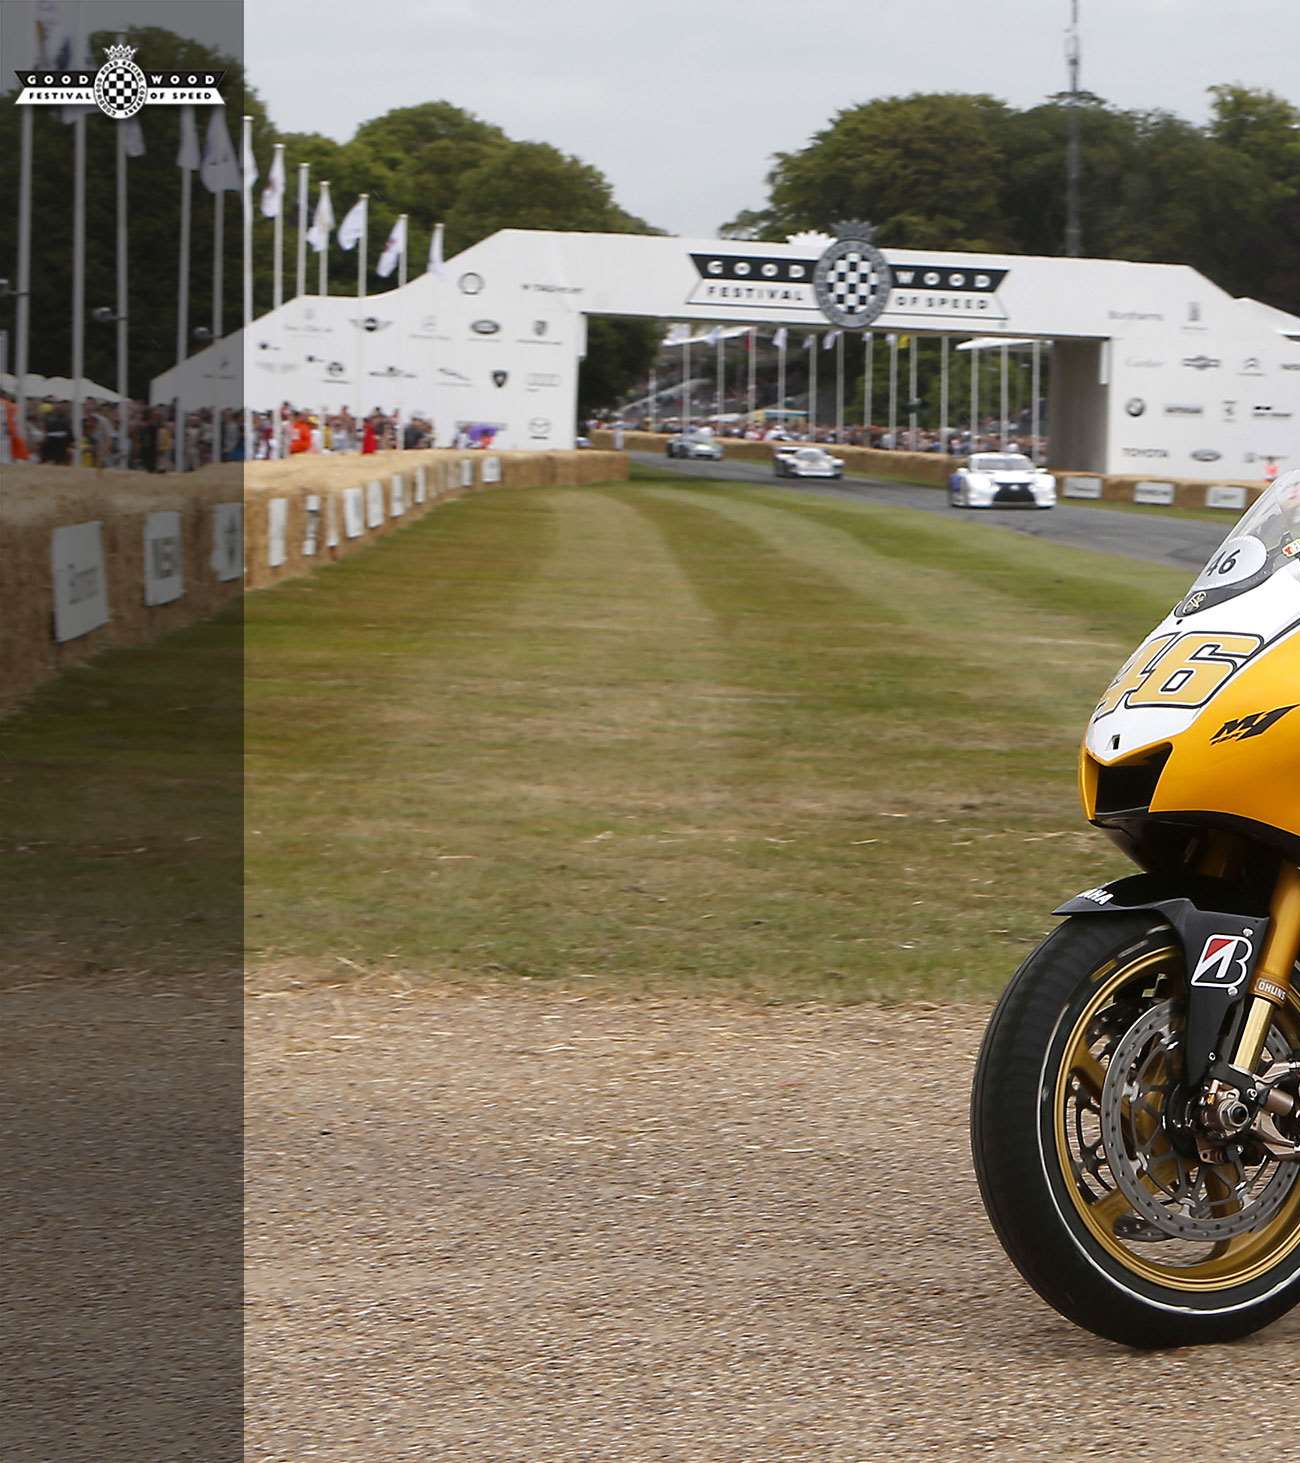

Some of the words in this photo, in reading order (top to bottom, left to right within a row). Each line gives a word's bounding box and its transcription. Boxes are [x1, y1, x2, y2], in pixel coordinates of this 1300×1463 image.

[708, 285, 803, 301] FESTIVAL
[897, 295, 919, 307] OF
[927, 297, 988, 310] SPEED
[1207, 549, 1241, 576] 46
